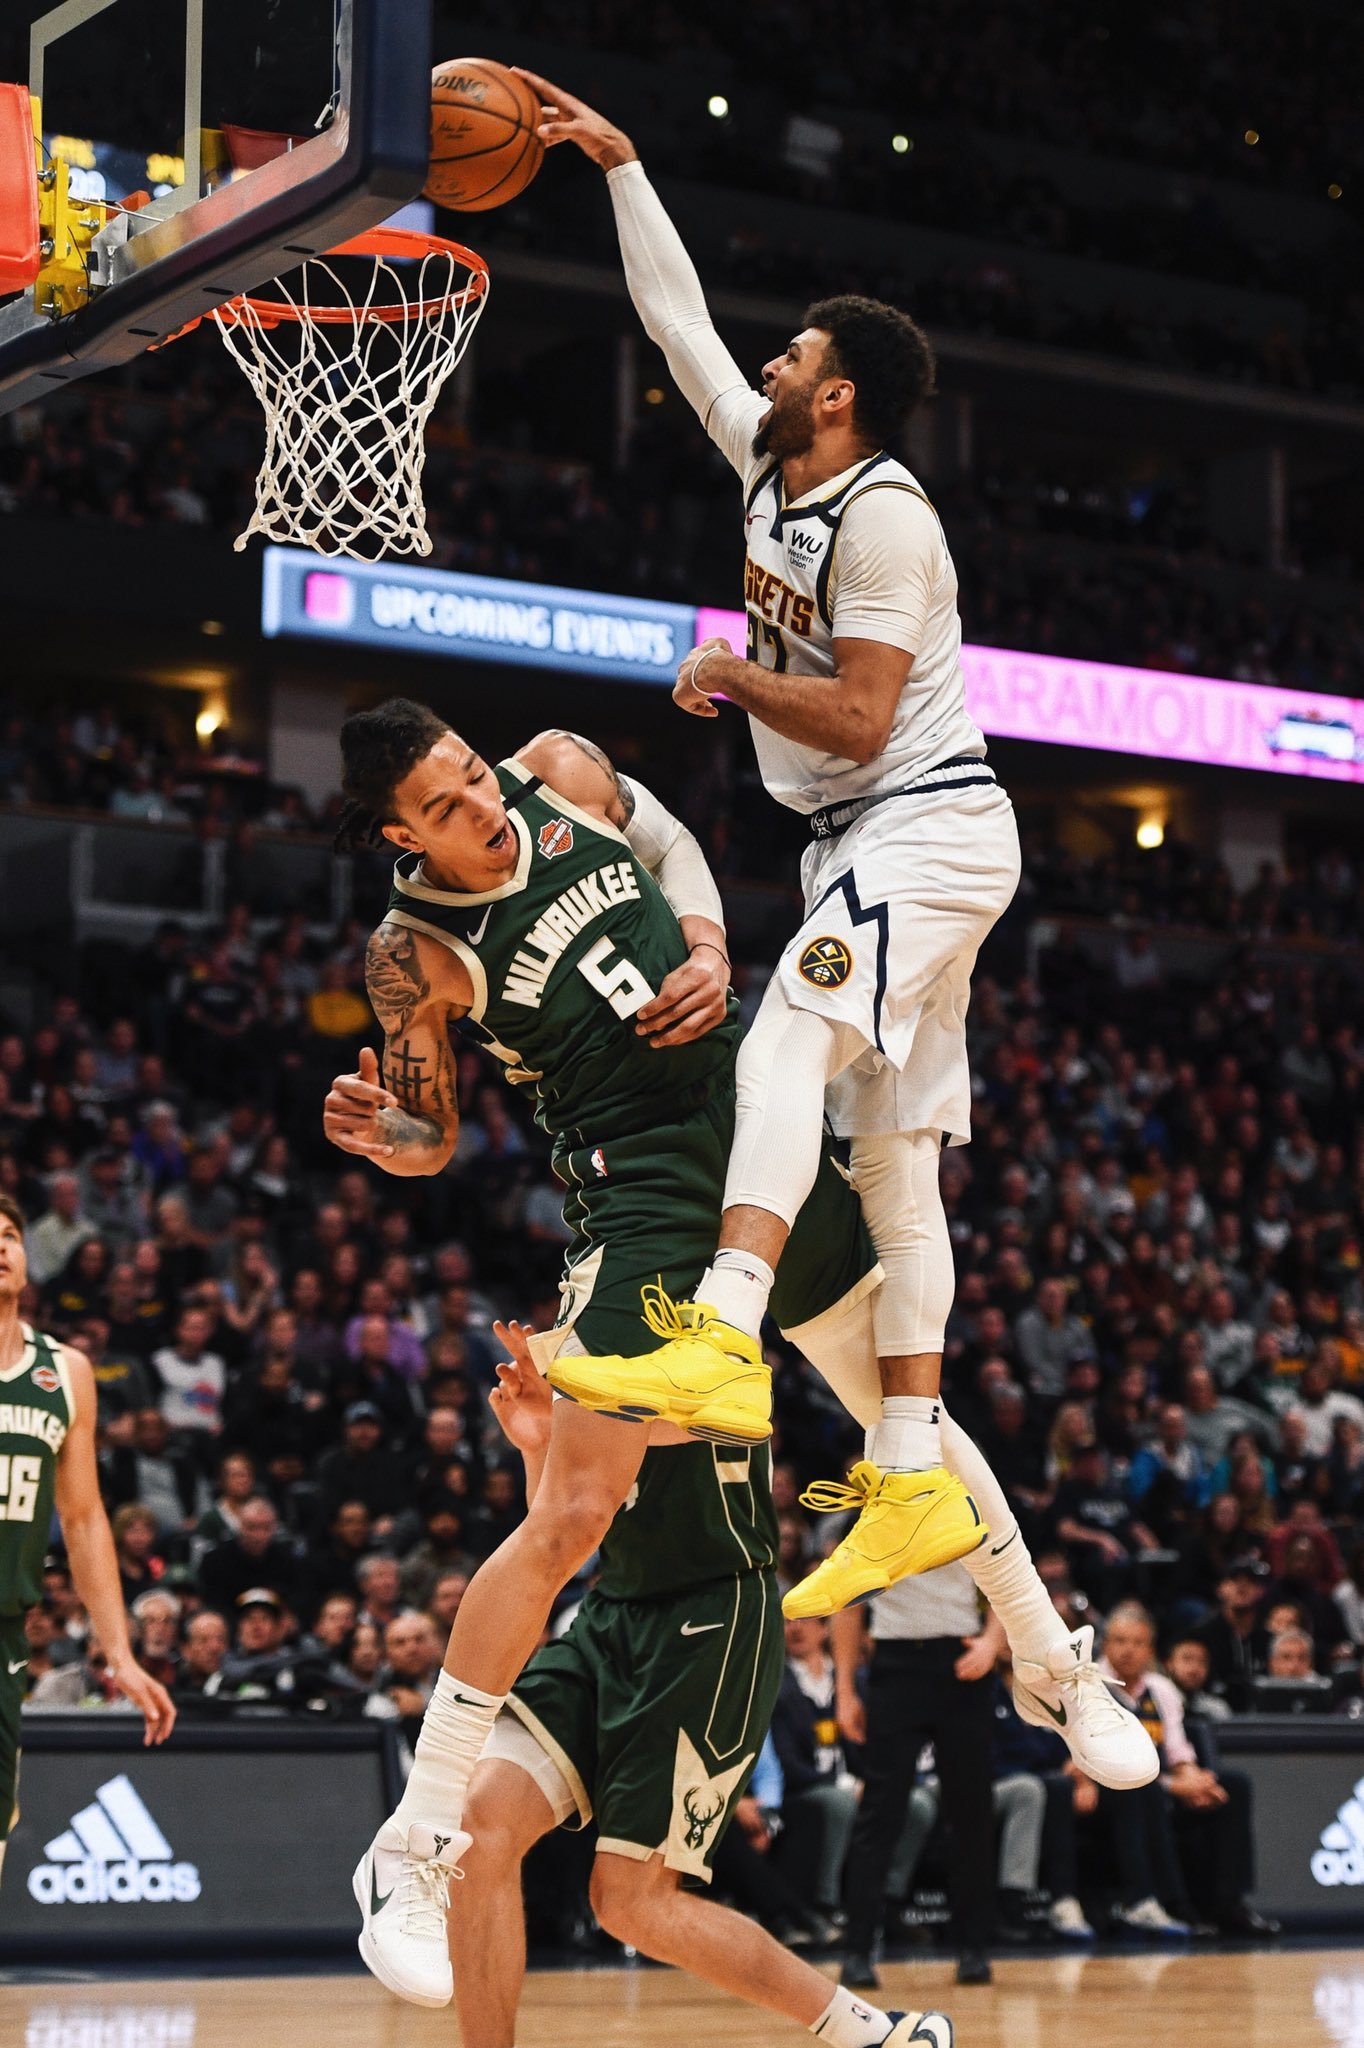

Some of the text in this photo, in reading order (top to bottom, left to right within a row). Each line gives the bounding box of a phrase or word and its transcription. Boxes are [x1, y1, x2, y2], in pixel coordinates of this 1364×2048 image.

[432, 75, 487, 103] DING
[787, 547, 814, 564] Western
[790, 557, 806, 569] Union
[791, 529, 823, 554] WU
[371, 583, 675, 665] UPCOMING EVENTS
[963, 660, 1266, 757] ARAMOUN
[501, 862, 642, 1009] MILWAUKEE
[576, 934, 656, 1021] 5
[27, 1857, 202, 1904] adidas
